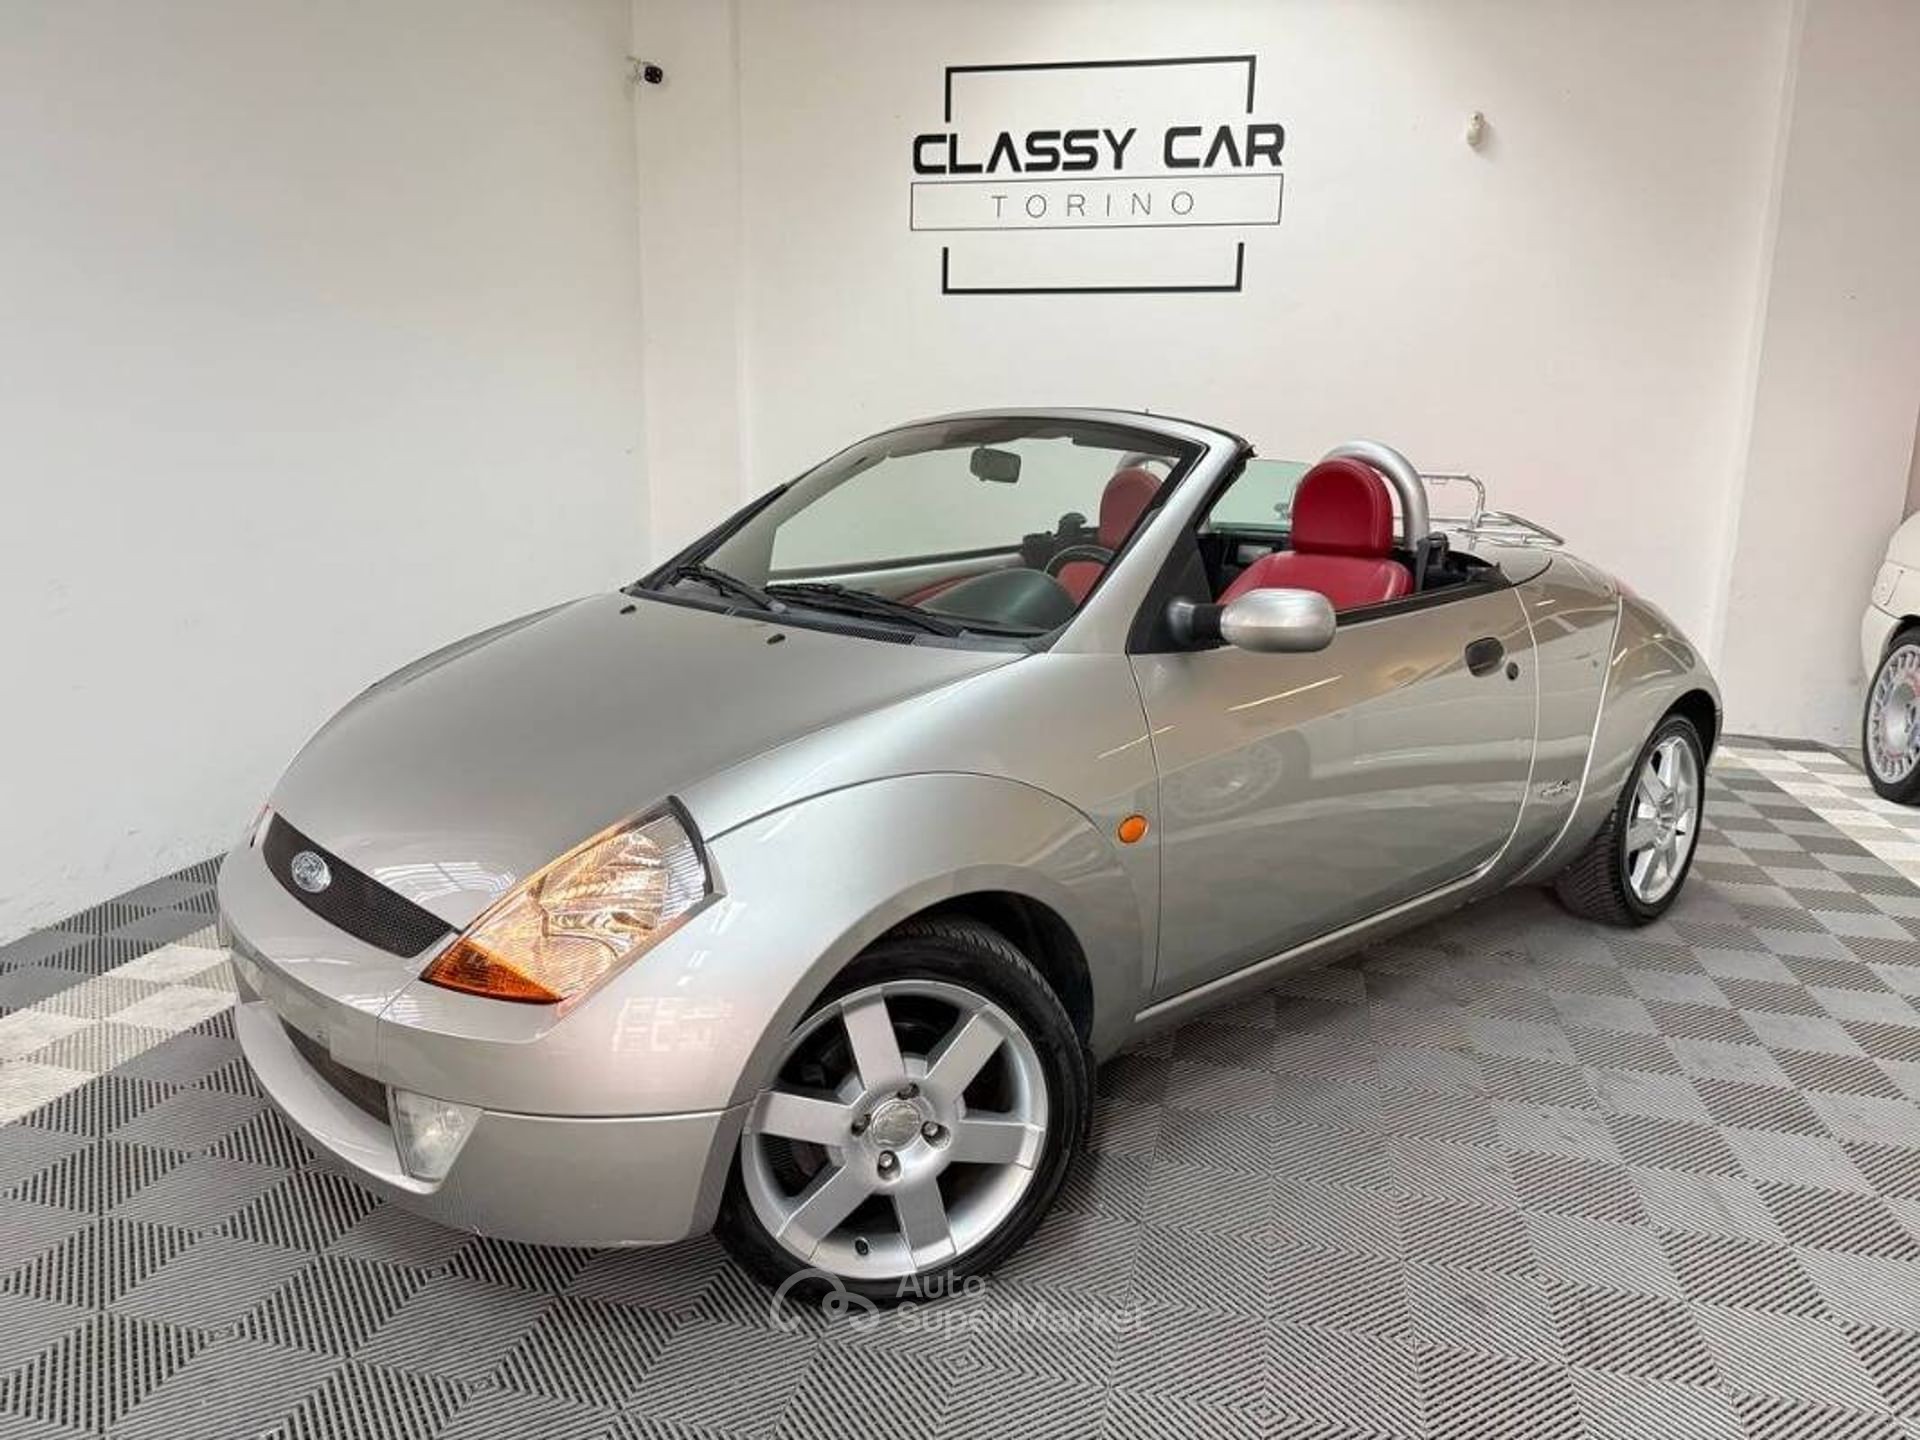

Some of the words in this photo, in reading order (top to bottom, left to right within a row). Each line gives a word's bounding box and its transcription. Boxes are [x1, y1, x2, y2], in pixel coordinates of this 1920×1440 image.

[913, 127, 1137, 174] CLASSY
[1164, 123, 1285, 168] CAR
[991, 191, 1194, 218] TORINO
